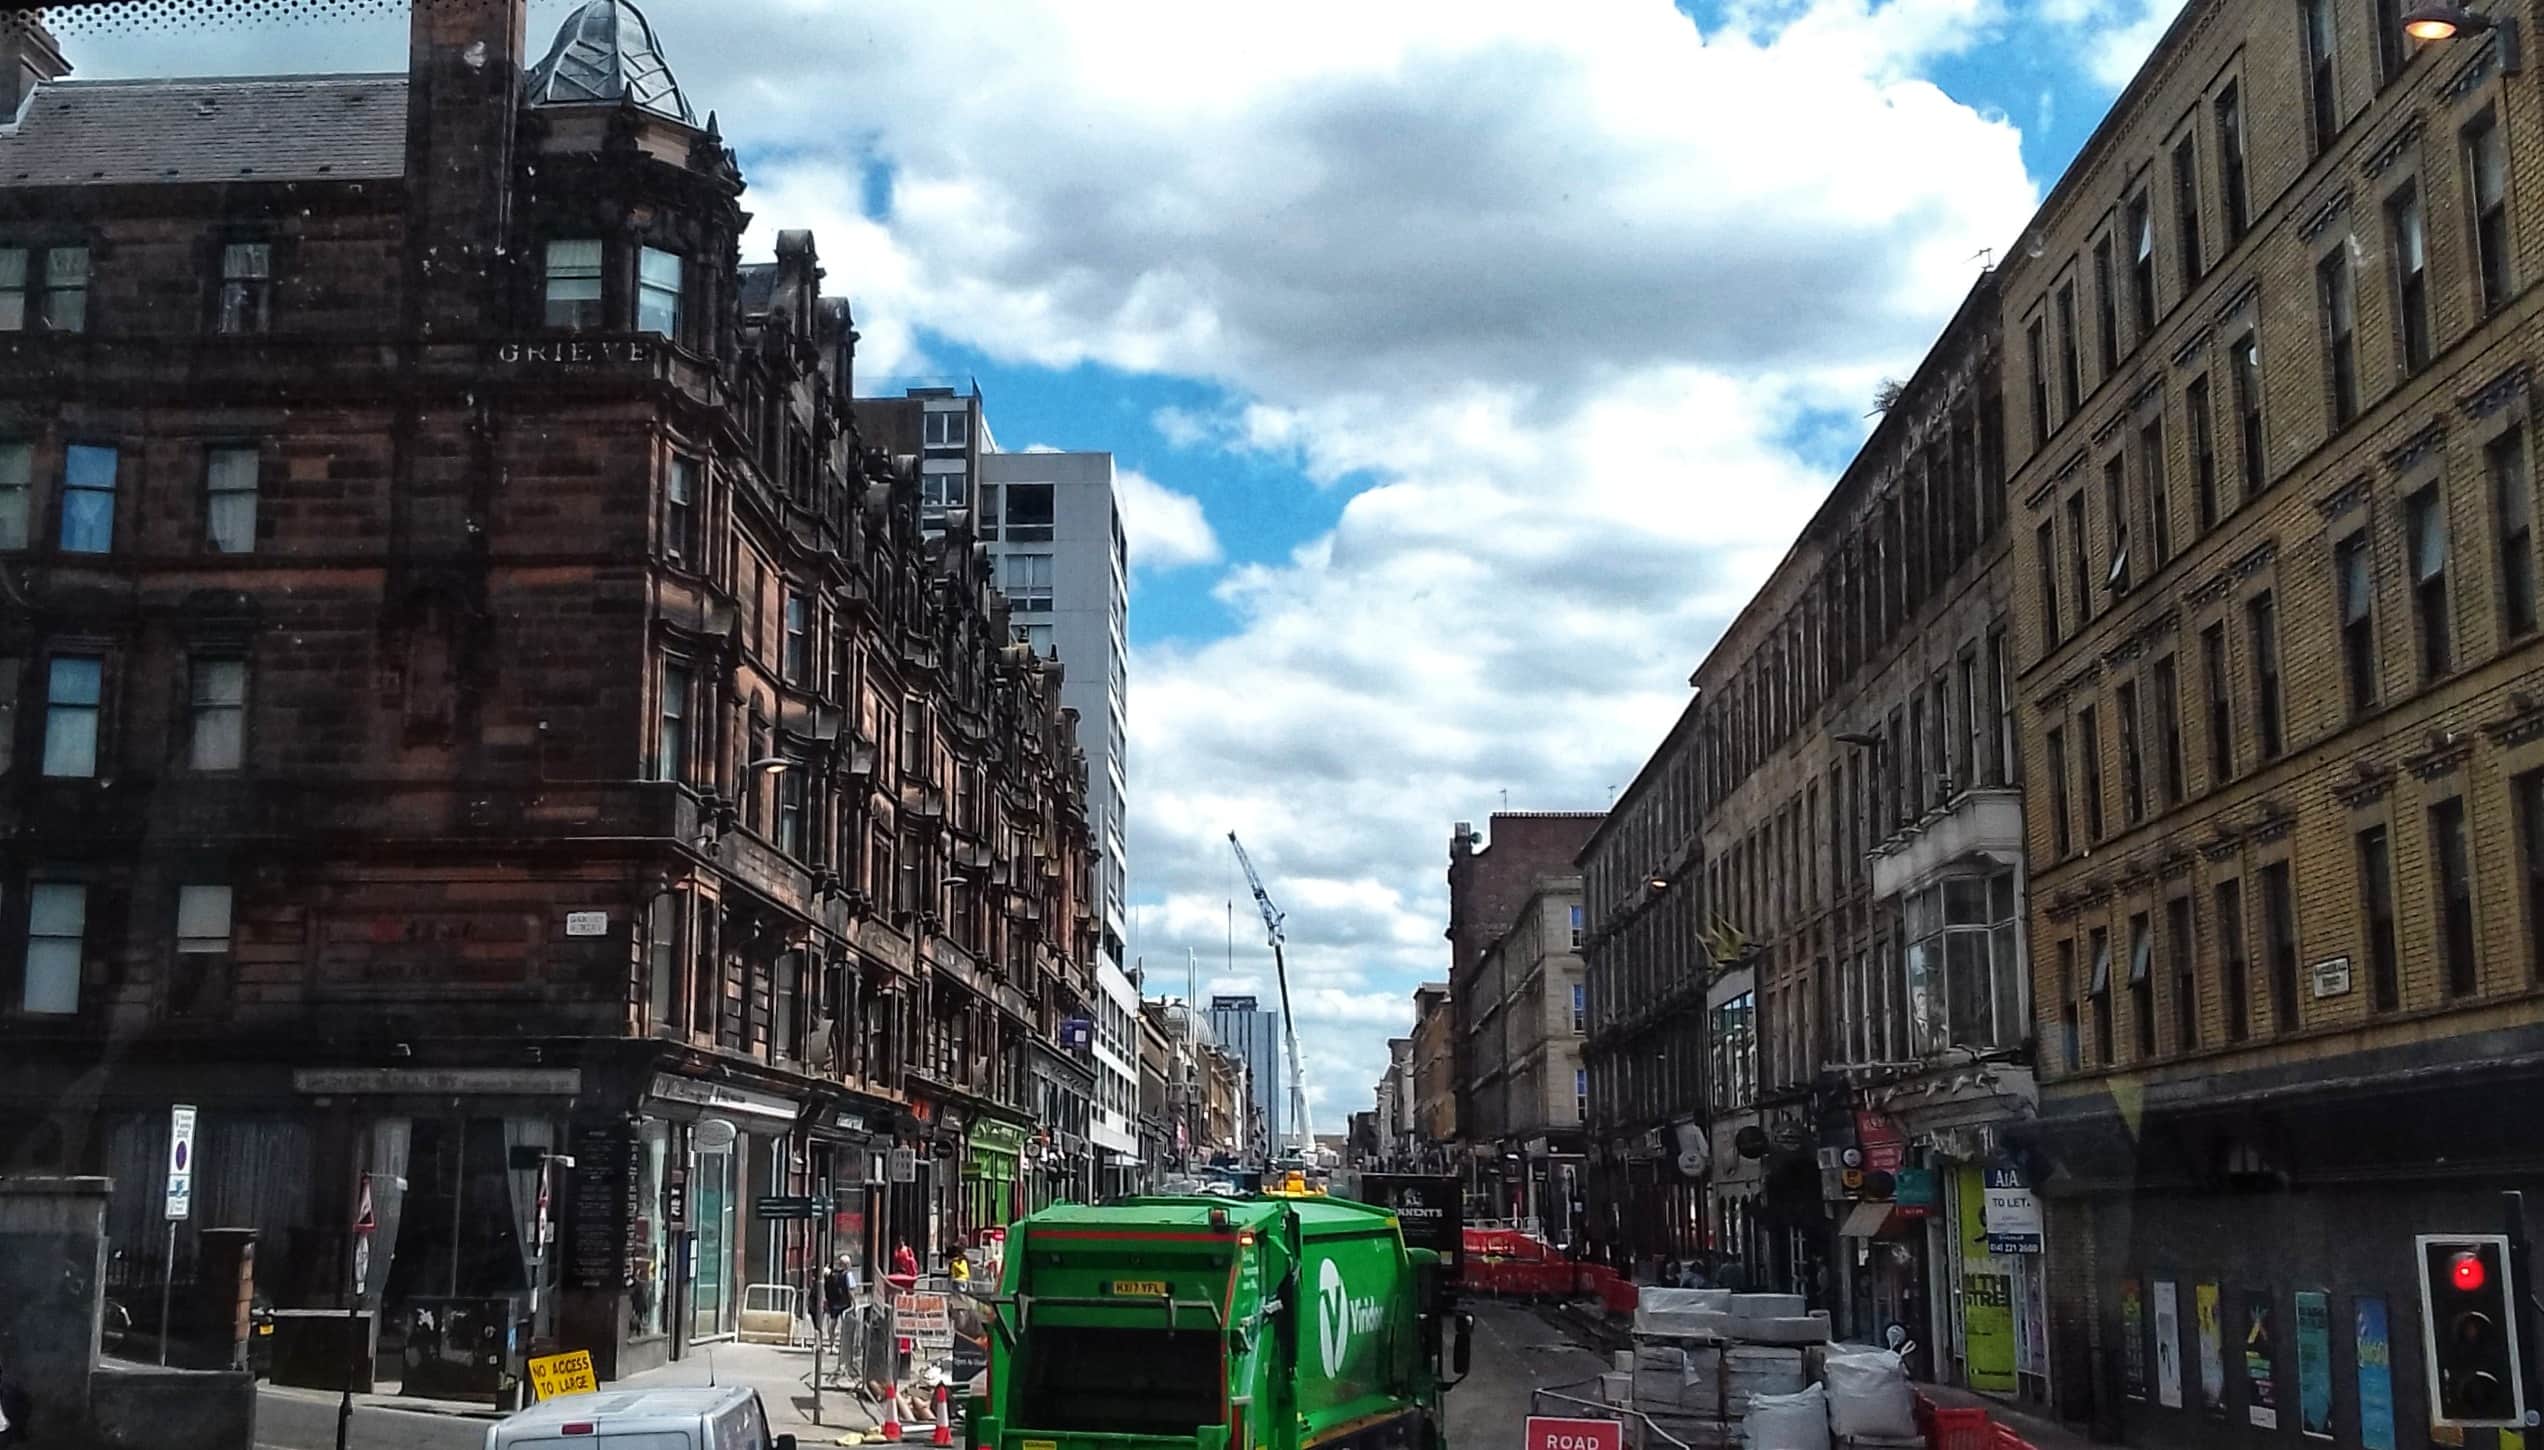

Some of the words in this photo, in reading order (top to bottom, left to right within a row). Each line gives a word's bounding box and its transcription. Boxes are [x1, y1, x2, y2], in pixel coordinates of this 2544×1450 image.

[499, 342, 650, 362] GRIEVE
[1992, 1197, 2005, 1207] TO
[533, 1364, 546, 1378] NO
[552, 1357, 589, 1374] ACCESS
[540, 1381, 554, 1395] TO
[559, 1375, 588, 1393] LARGE
[1546, 1434, 1599, 1450] ROAD
